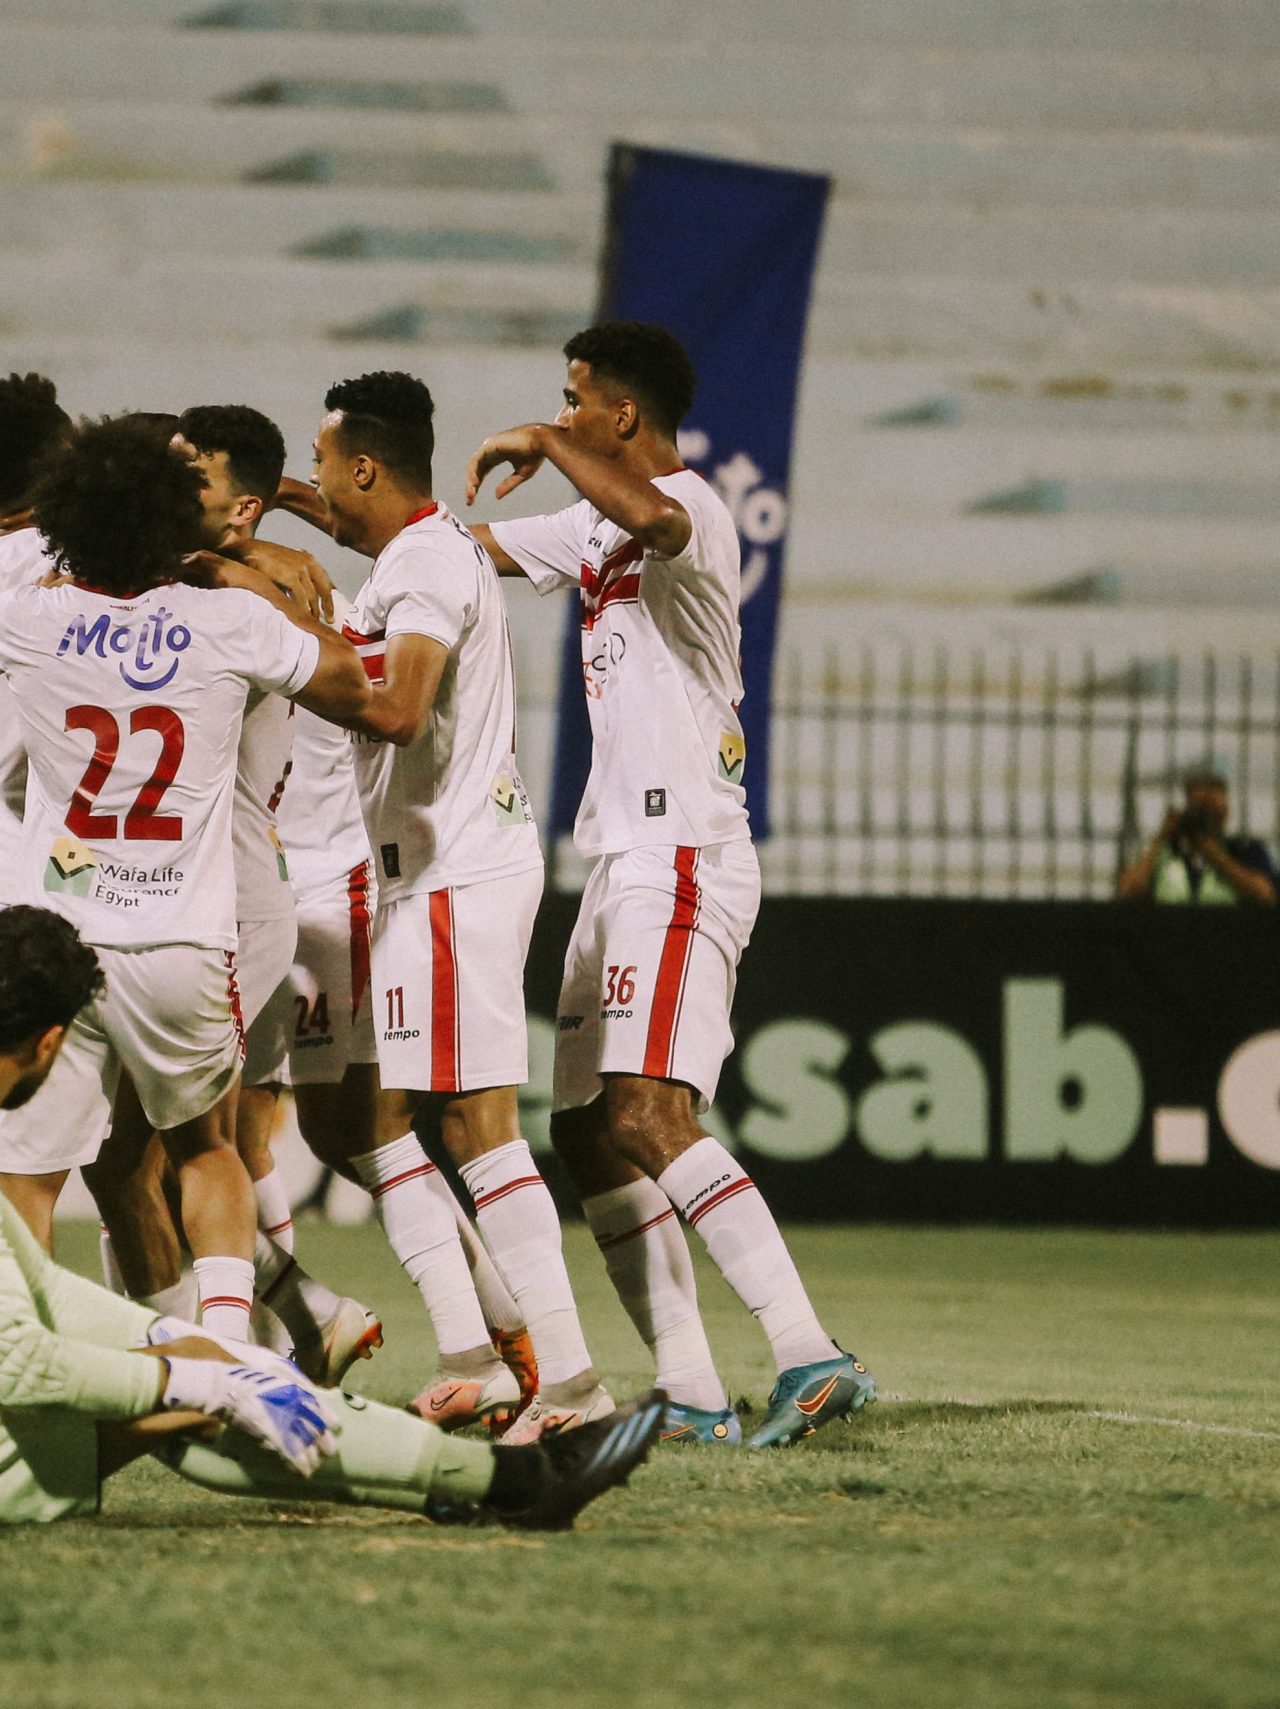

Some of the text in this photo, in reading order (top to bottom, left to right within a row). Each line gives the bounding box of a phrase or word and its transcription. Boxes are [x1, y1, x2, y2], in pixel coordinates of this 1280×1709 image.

[63, 704, 185, 841] 22
[99, 862, 184, 883] Wafa Life
[95, 885, 140, 908] Egypt
[603, 965, 638, 1007] 36
[294, 992, 331, 1036] 24
[385, 986, 404, 1029] 11
[384, 1028, 420, 1042] tempo
